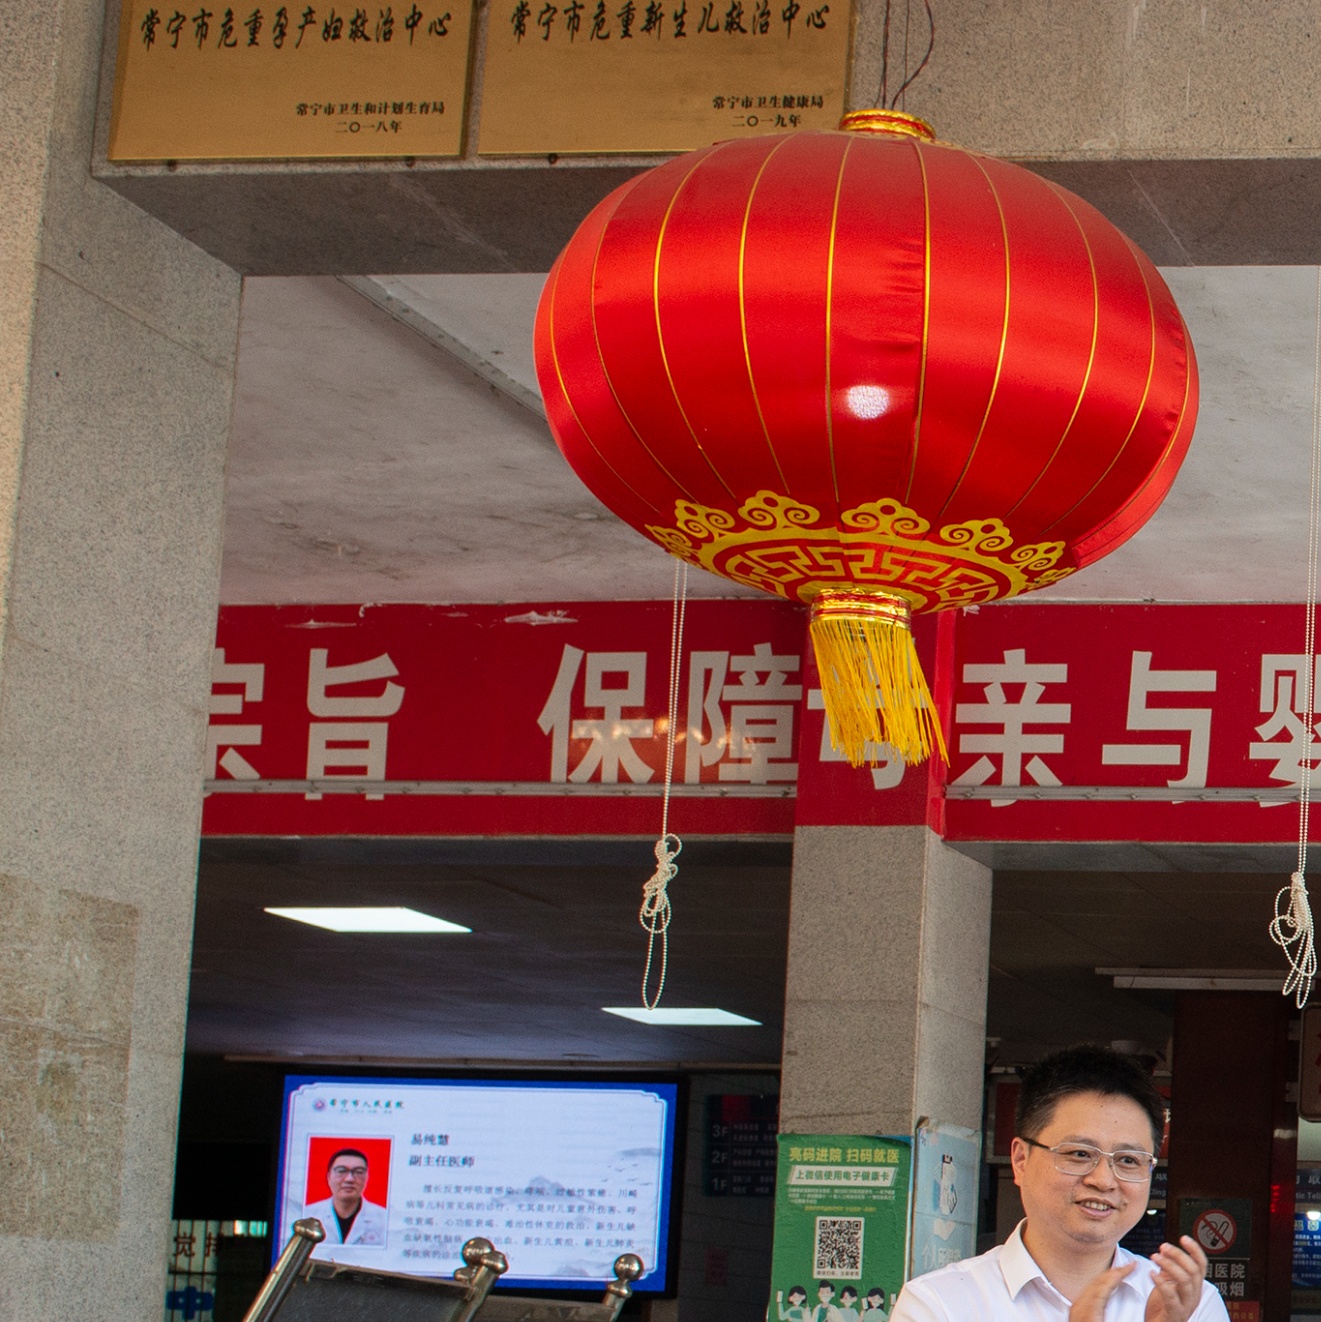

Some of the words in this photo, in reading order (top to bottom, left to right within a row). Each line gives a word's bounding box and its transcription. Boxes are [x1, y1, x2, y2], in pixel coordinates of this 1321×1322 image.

[141, 4, 451, 50] 常宁市危重孕产妇救治中心
[510, 0, 830, 43] 常宁市危重新生儿救治中心
[296, 102, 445, 116] 常宁市卫生和计划生育局
[713, 95, 824, 109] 常宁市卫生健康局
[409, 1154, 474, 1169] 副主任医师
[789, 1147, 842, 1162] 亮码进院
[846, 1149, 900, 1163] 扫码就医
[795, 1169, 890, 1182] 上微信使用电子健康卡
